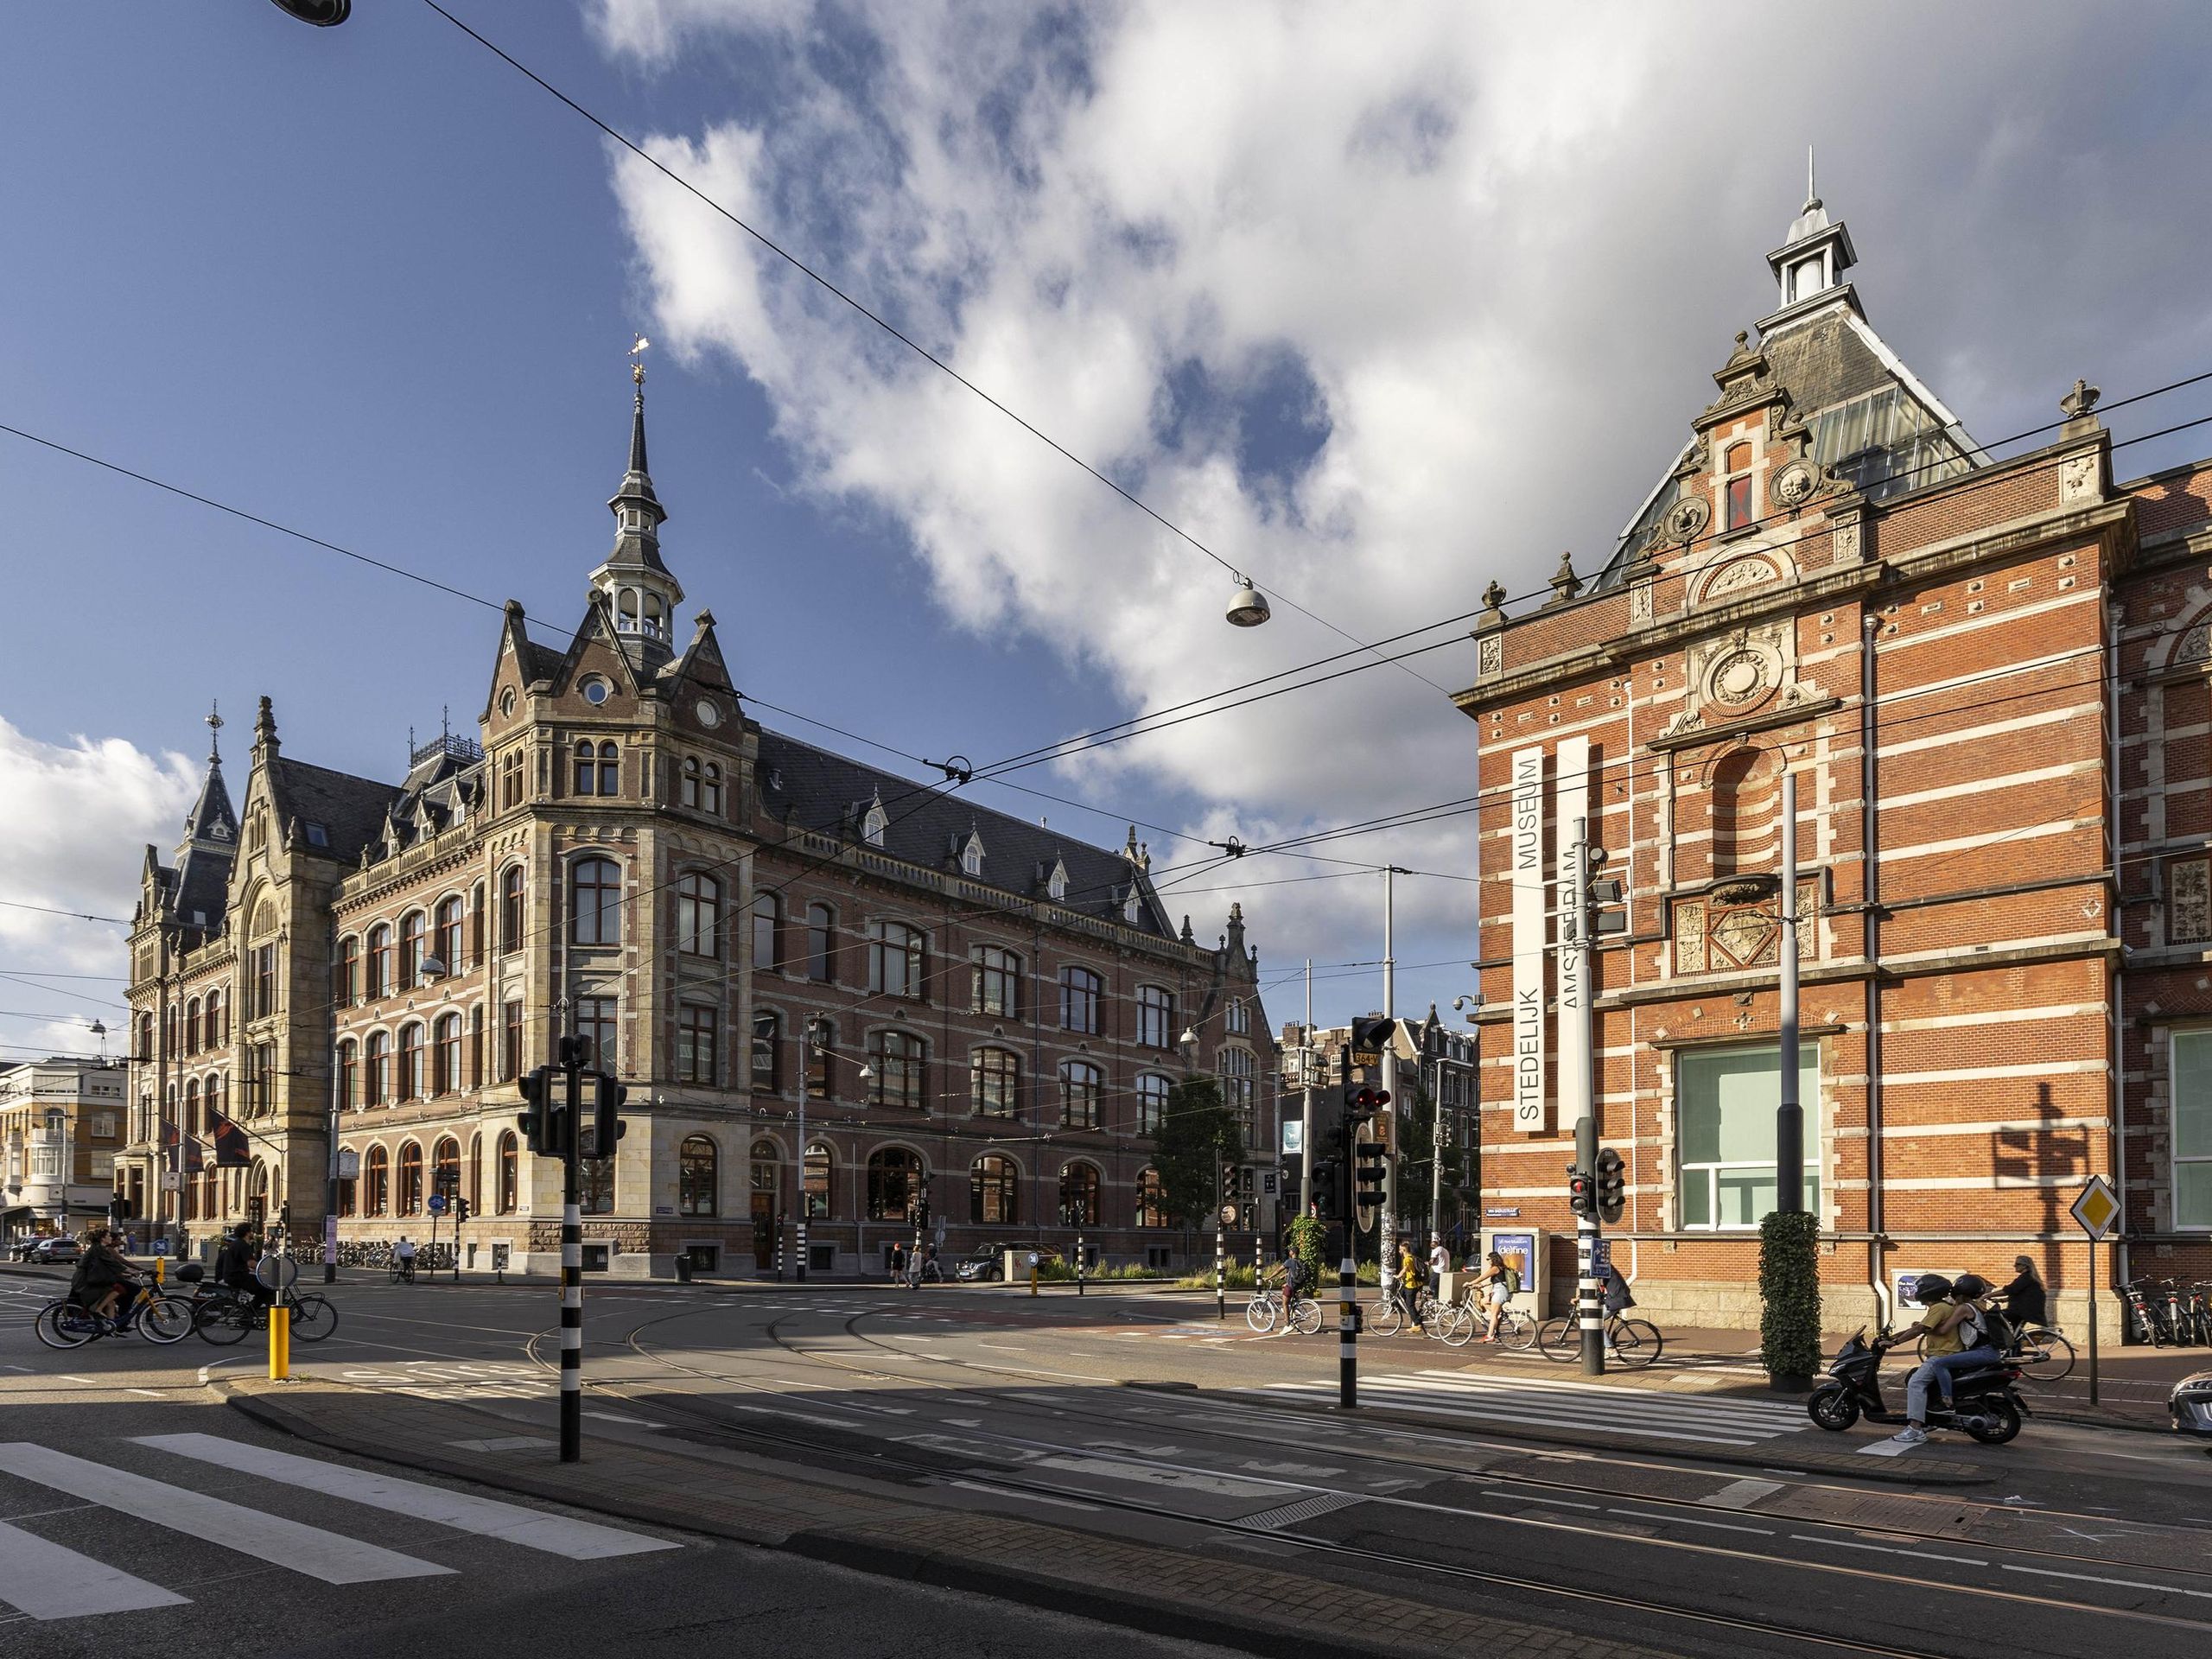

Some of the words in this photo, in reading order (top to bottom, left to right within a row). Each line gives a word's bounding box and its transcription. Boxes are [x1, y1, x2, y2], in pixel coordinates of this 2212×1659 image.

[1518, 759, 1537, 870] MUSEUM
[1519, 988, 1539, 1120] STEDELIJK
[1497, 1245, 1529, 1255] (de)fine
